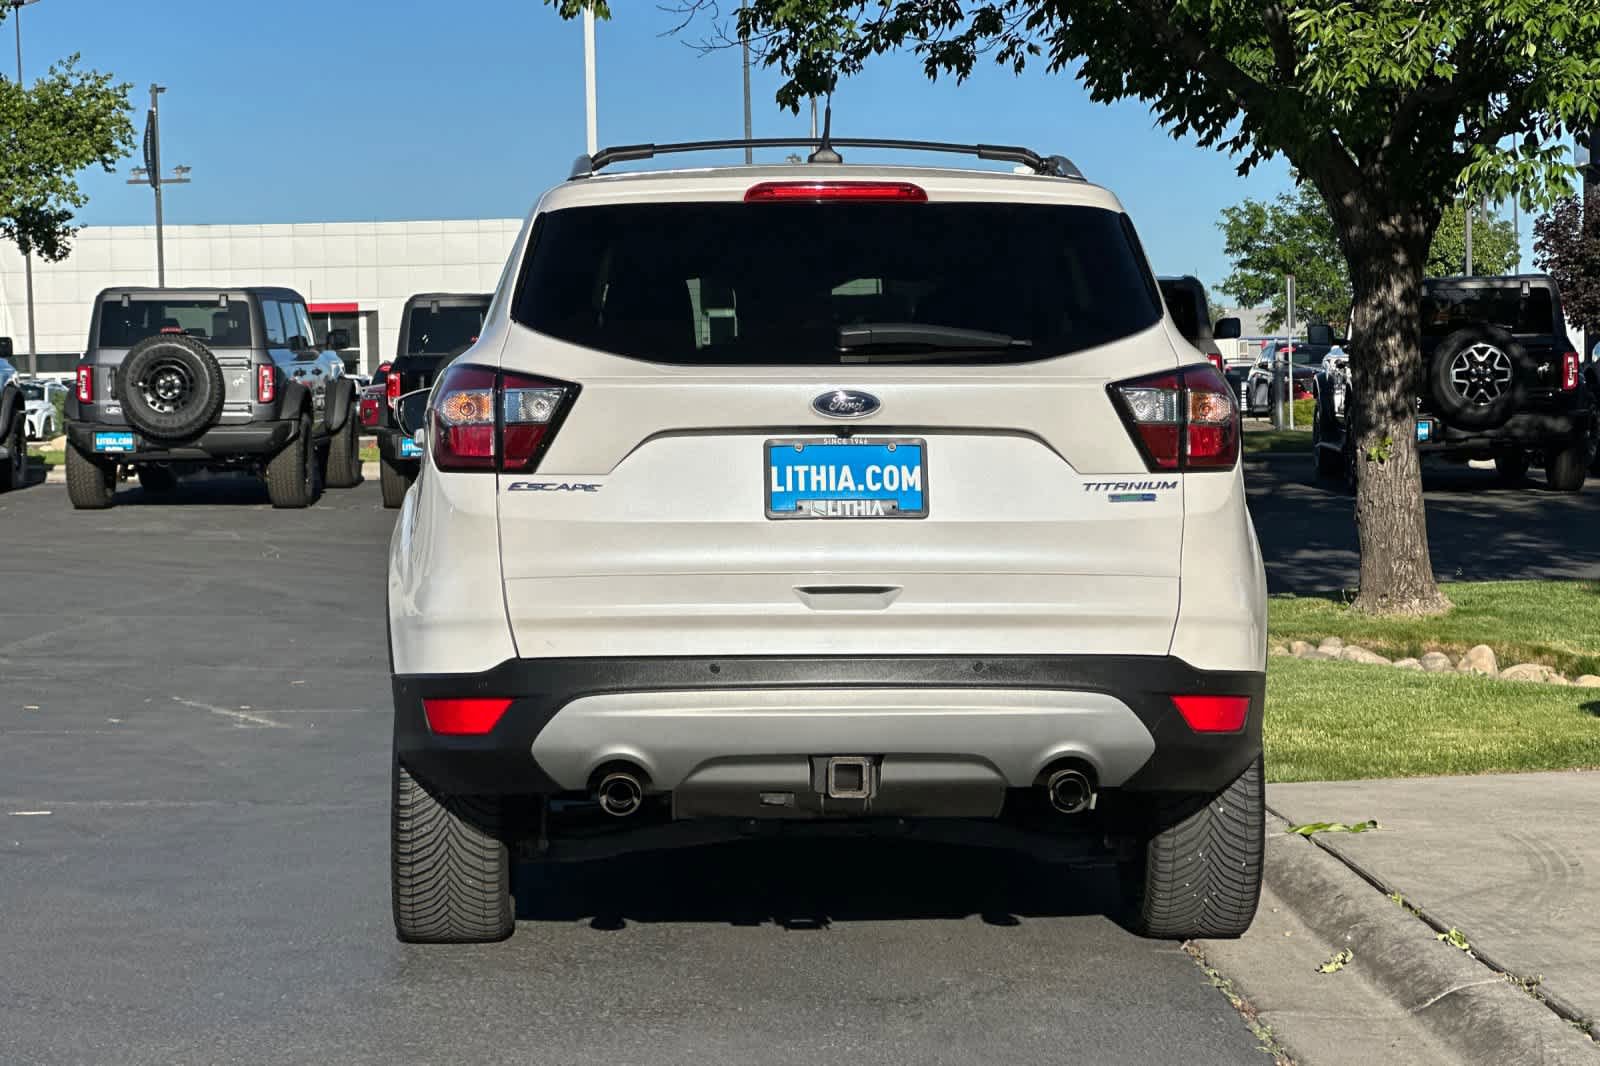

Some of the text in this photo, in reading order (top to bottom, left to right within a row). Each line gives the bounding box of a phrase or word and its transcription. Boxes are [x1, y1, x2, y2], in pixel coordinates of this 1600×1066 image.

[829, 390, 865, 411] Ford
[823, 438, 848, 446] SINCE
[771, 465, 921, 492] LITHIA.COM
[508, 481, 603, 493] ESCAPE
[1083, 480, 1178, 492] TITANIUM
[827, 500, 885, 516] LITHIA
